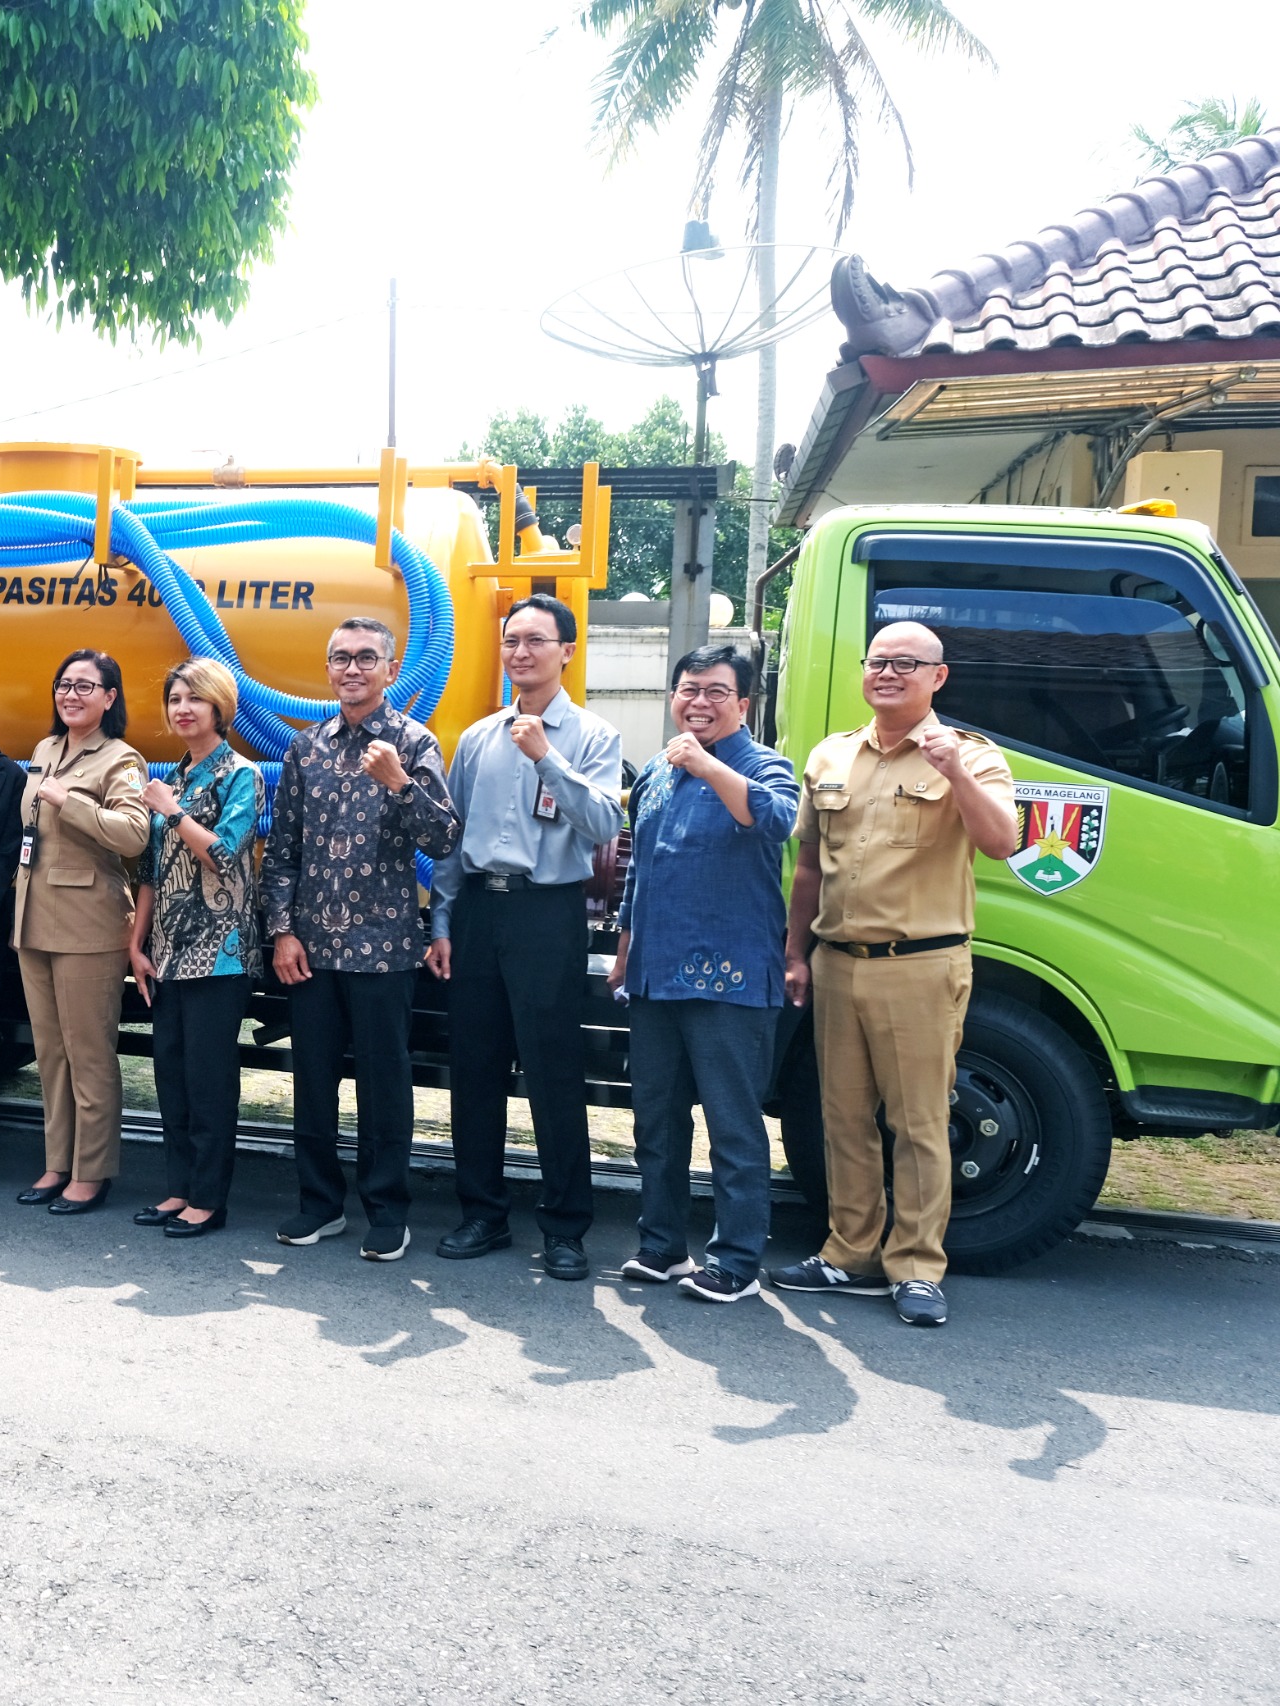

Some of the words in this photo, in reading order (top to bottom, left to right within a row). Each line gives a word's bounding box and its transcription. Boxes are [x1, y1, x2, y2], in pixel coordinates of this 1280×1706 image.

[127, 578, 206, 607] 40
[216, 580, 314, 610] LITER
[1015, 787, 1042, 796] KOTA
[1044, 789, 1101, 800] MAGELANG
